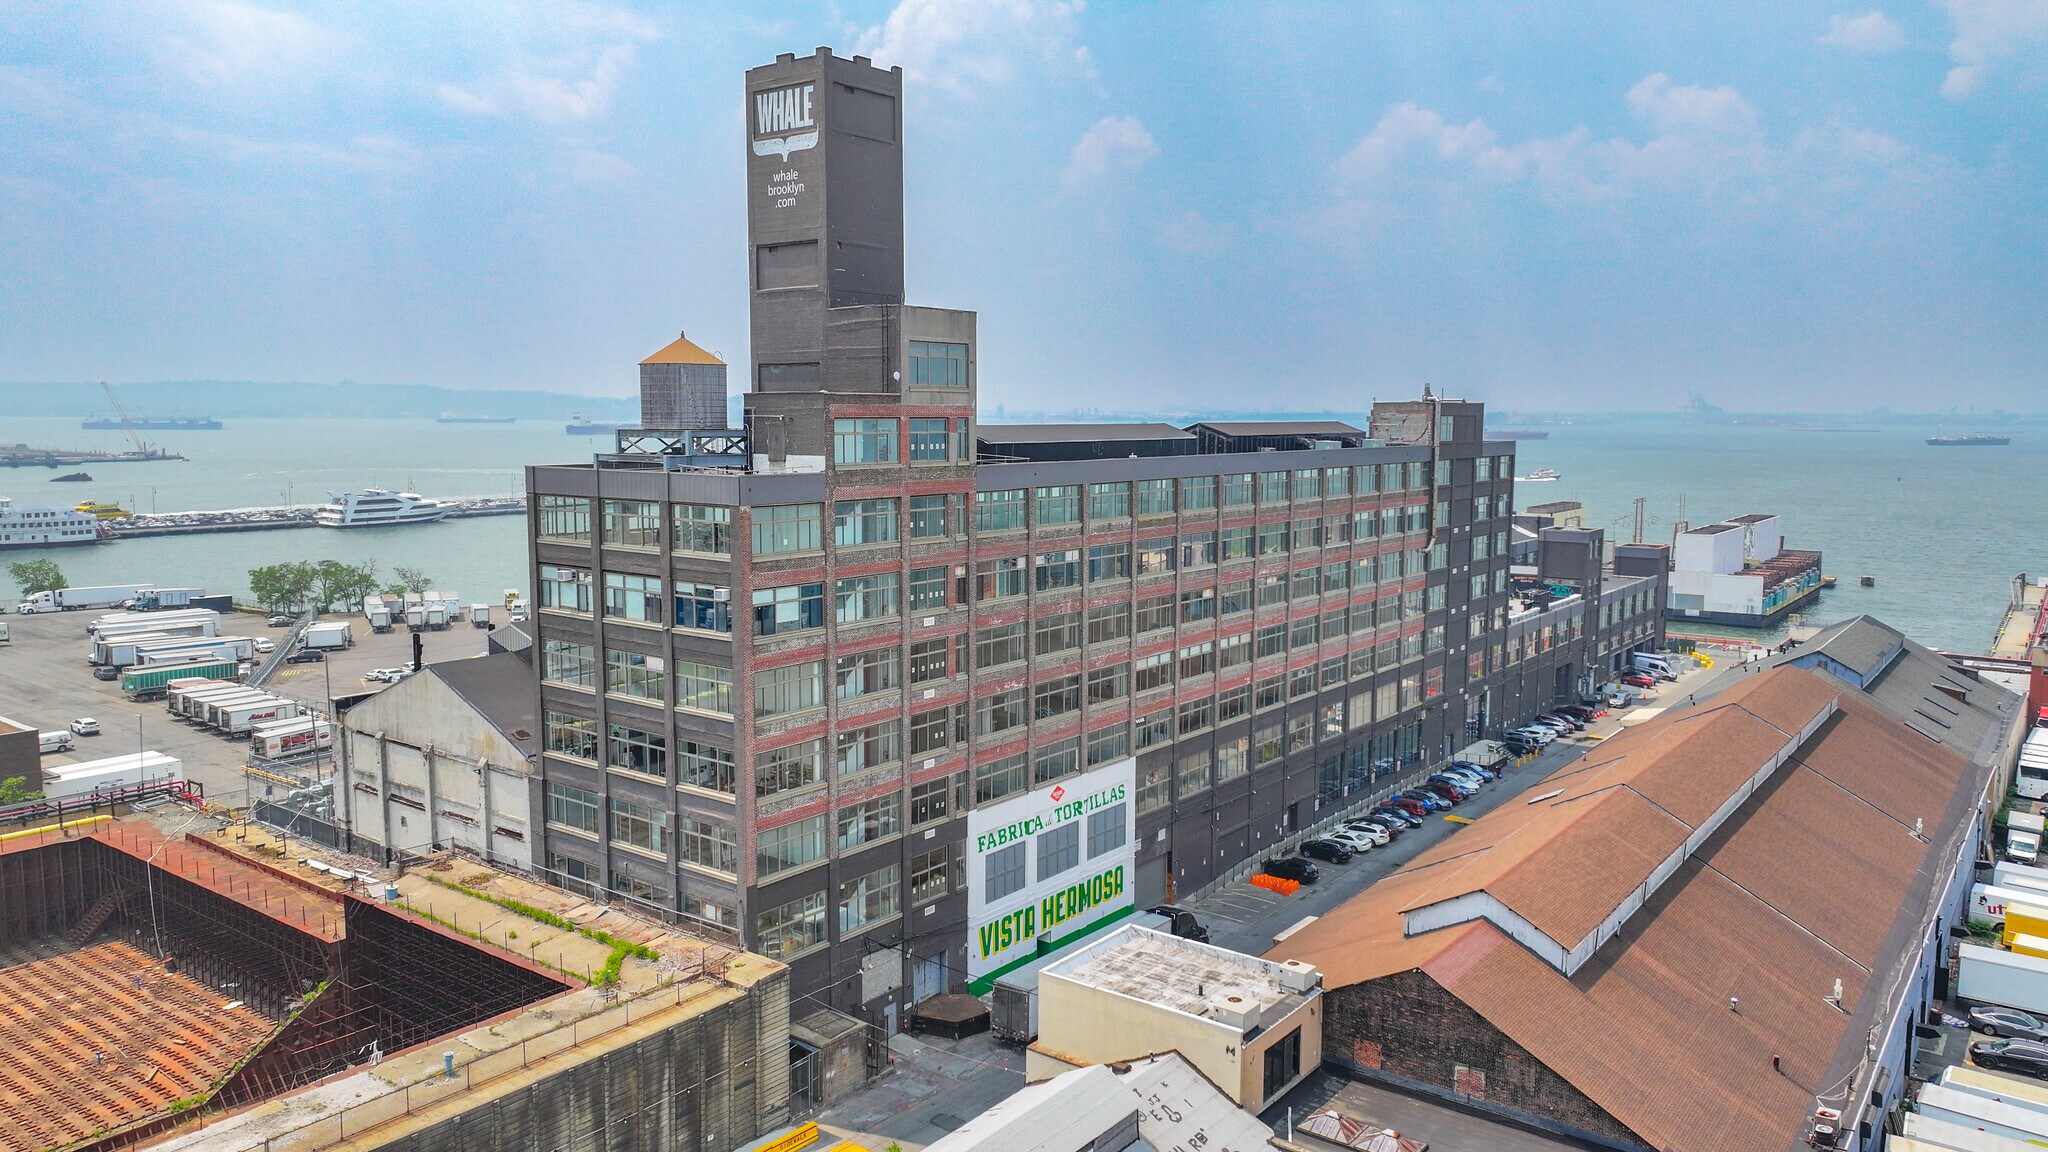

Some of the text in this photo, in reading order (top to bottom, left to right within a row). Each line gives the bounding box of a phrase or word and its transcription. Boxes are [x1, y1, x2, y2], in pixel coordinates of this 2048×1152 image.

[757, 85, 814, 134] WHALE
[773, 169, 799, 182] whale
[767, 181, 805, 196] brooklyn
[775, 197, 796, 208] .com
[977, 815, 1043, 853] FABRICA
[1055, 784, 1126, 823] TORTILLAS
[978, 864, 1124, 961] VISTA HERMOSA
[1987, 904, 2007, 915] ut
[779, 1132, 808, 1151] SIDEWALK
